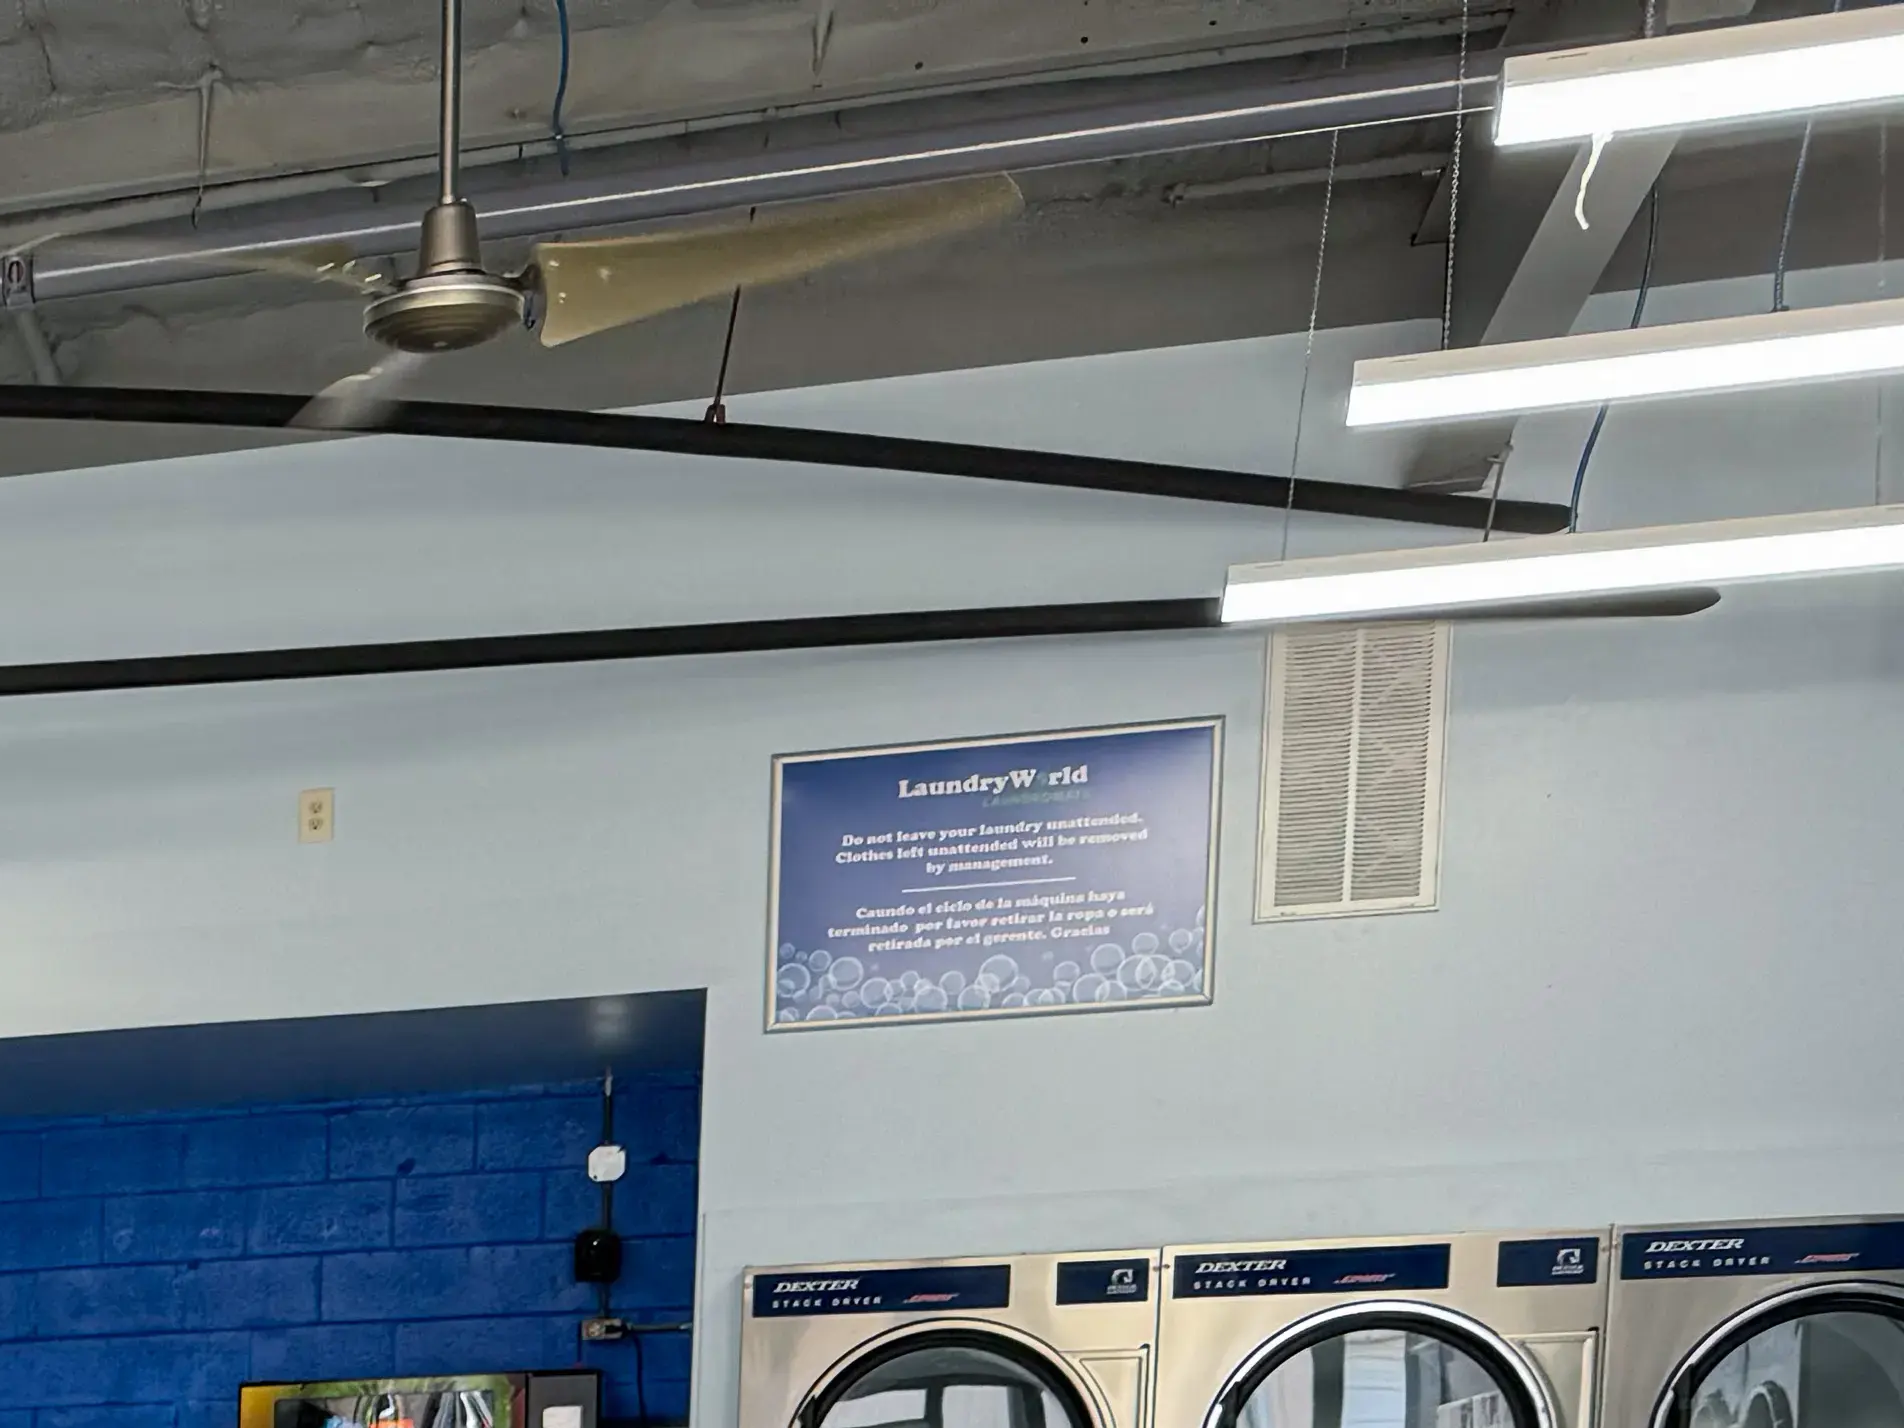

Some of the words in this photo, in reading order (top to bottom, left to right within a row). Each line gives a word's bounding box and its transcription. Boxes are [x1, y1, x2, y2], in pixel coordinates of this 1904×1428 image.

[899, 765, 1088, 798] LaundryWrld
[841, 834, 864, 847] Do
[866, 832, 893, 845] not
[896, 830, 936, 843] leave
[938, 827, 977, 842] your
[979, 821, 1043, 836] laundry
[1046, 812, 1144, 830] unattended.
[835, 849, 894, 864] Clothes
[897, 846, 924, 859] left
[927, 838, 1018, 856] unattended
[1021, 835, 1054, 849] will
[1057, 834, 1076, 846] be
[1079, 828, 1148, 845] removed
[926, 862, 946, 876] by
[948, 854, 1053, 872] management.
[1646, 1238, 1745, 1253] DEXTER
[1195, 1259, 1286, 1273] DEXTER
[1644, 1260, 1701, 1270] STACK
[773, 1279, 860, 1293] DEXTER
[1193, 1278, 1247, 1290] STACK
[772, 1299, 822, 1309] STACK
